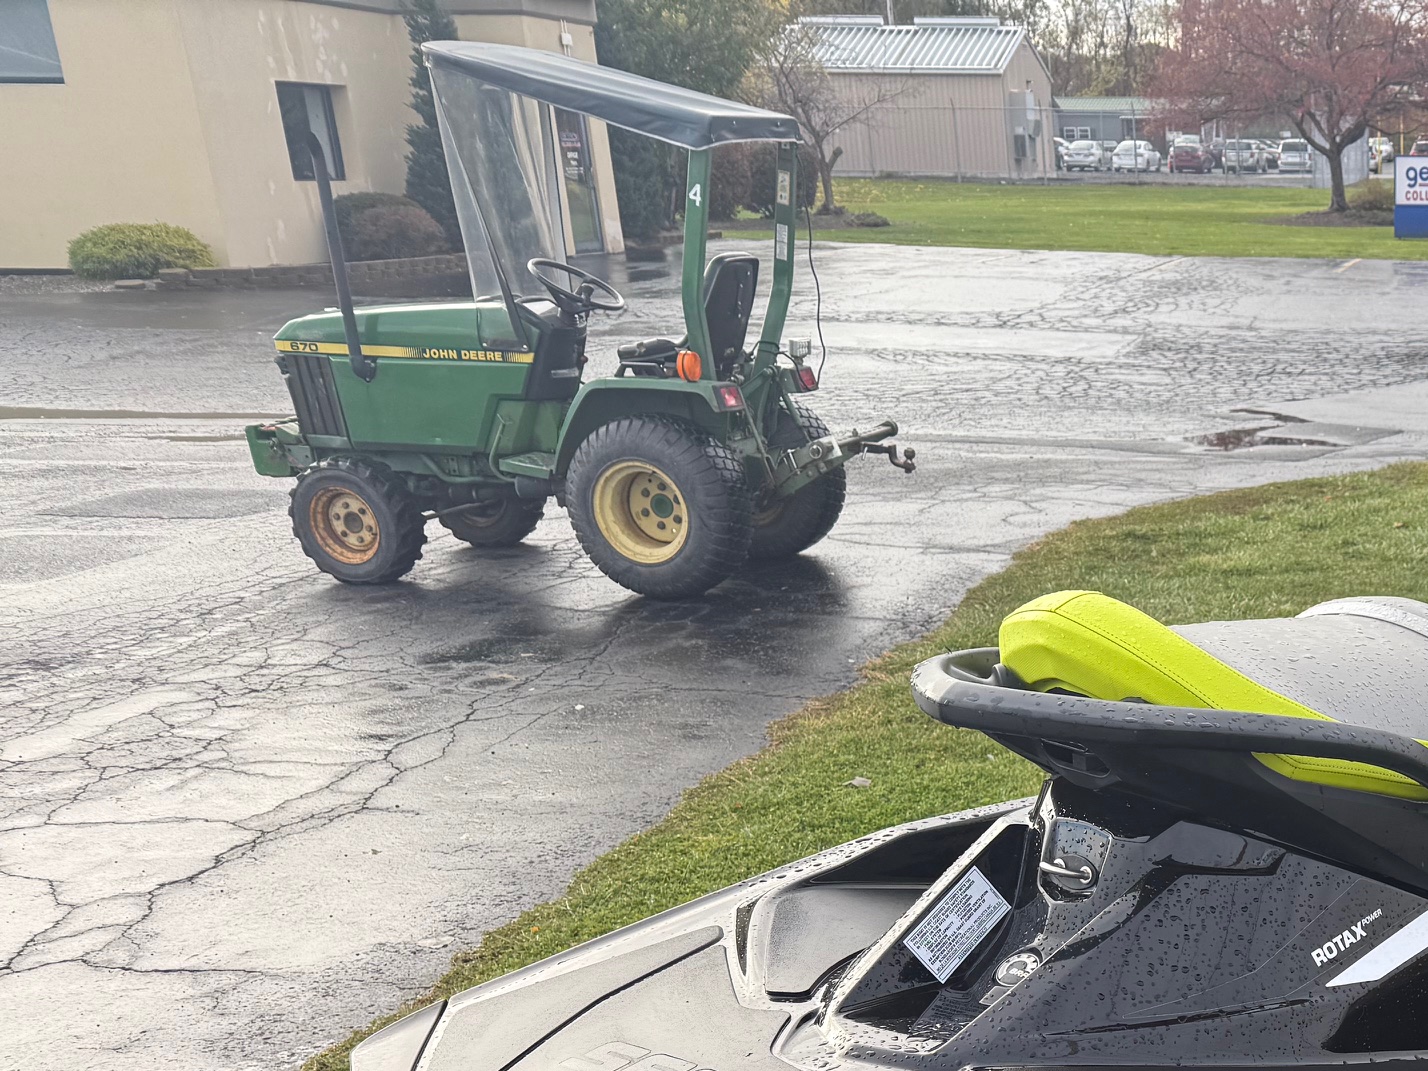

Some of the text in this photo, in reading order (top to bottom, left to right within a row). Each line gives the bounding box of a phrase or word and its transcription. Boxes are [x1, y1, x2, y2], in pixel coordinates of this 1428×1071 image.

[688, 184, 702, 206] 4
[290, 341, 318, 352] 670
[423, 348, 502, 362] JOHN DEERE
[1310, 908, 1383, 967] ROTAX POWER
